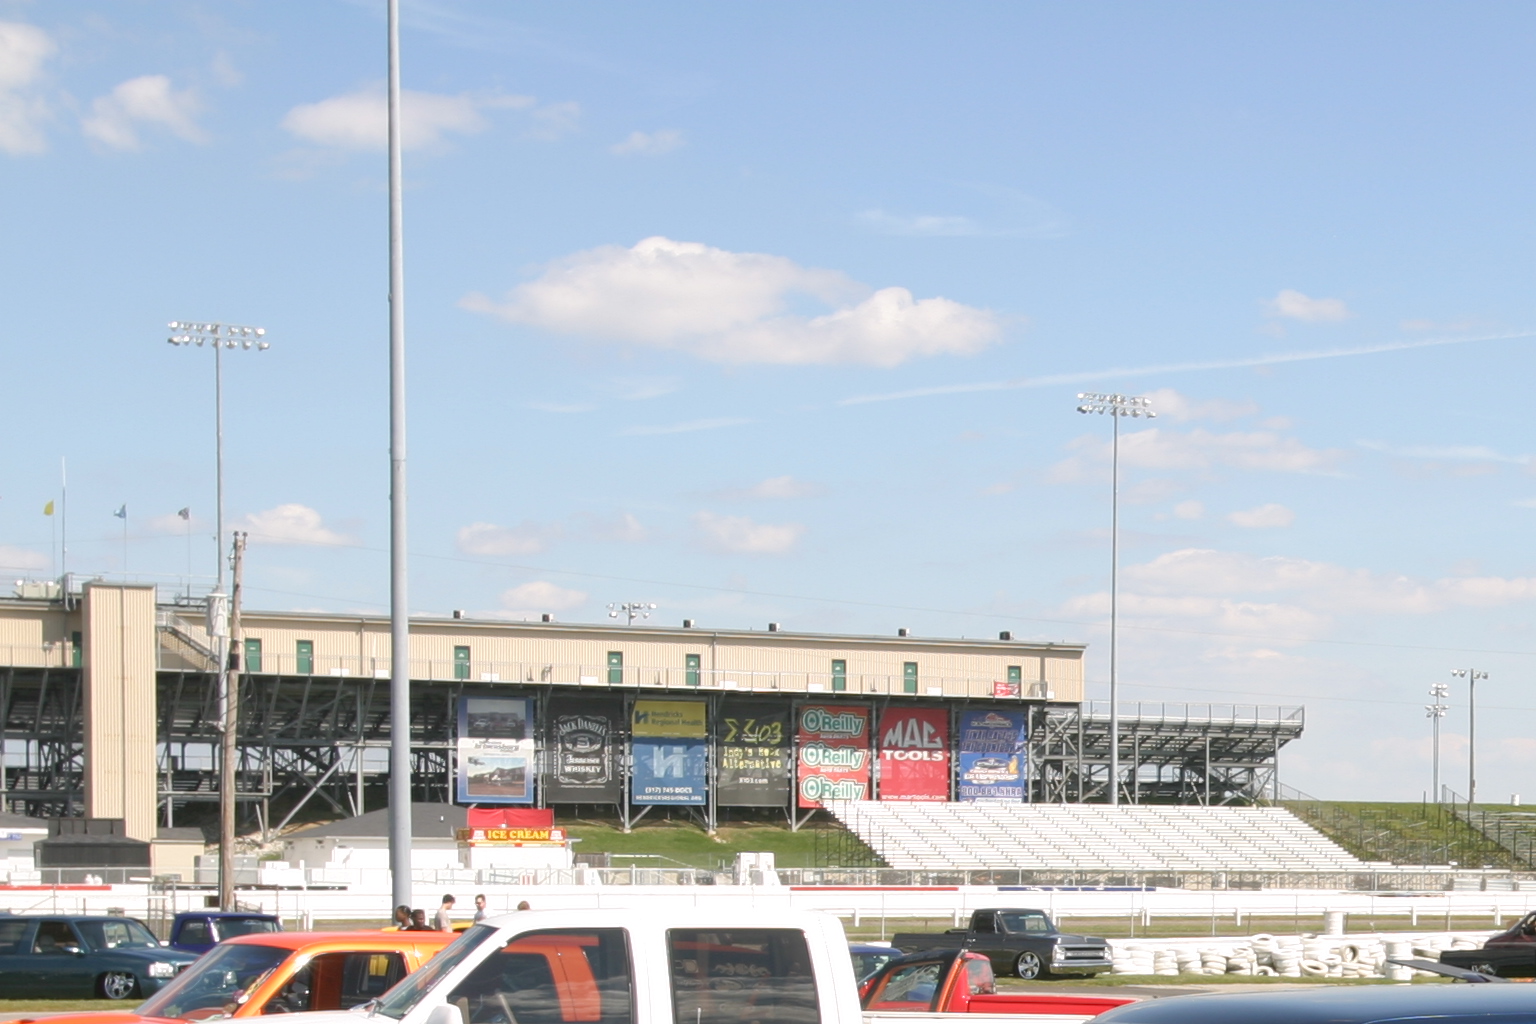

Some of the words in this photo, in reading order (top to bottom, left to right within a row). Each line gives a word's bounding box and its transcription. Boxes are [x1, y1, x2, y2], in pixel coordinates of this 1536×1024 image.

[804, 710, 863, 734] O'Reilly
[882, 718, 943, 748] MAC
[722, 758, 782, 769] Alternative
[804, 743, 863, 768] O'Reilly
[882, 750, 944, 761] TOOLS
[804, 777, 863, 801] O'Reilly
[487, 830, 507, 839] ICE
[509, 830, 549, 839] CREAM
